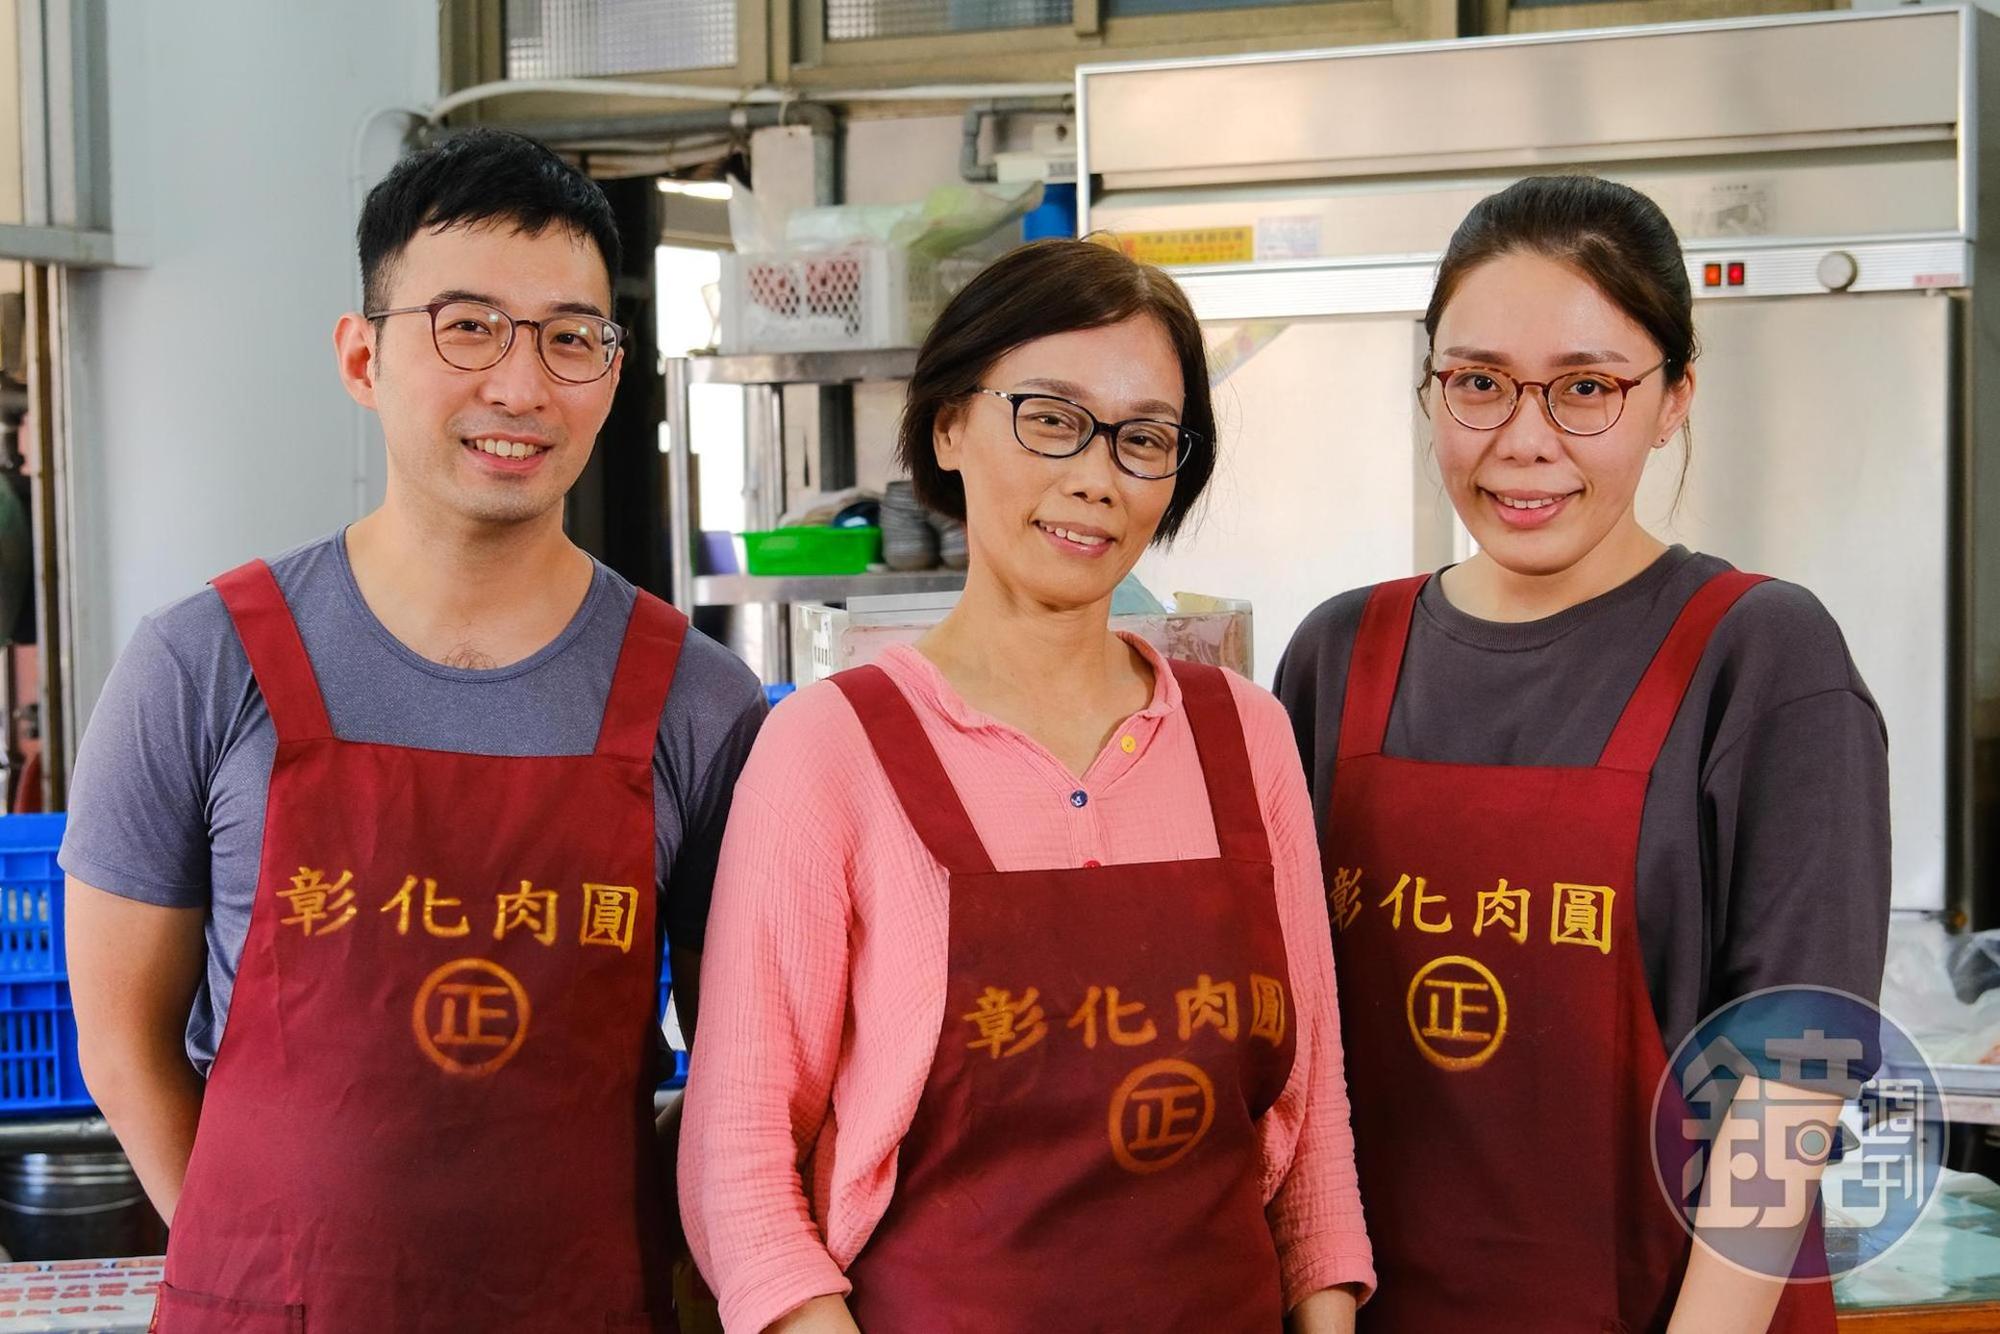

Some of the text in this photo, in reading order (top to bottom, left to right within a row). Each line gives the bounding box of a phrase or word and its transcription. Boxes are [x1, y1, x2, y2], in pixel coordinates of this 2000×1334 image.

[276, 866, 639, 953] 彰化肉圓
[1329, 866, 1617, 955] 彰化肉圓
[962, 973, 1286, 1060] 彰化肉圓
